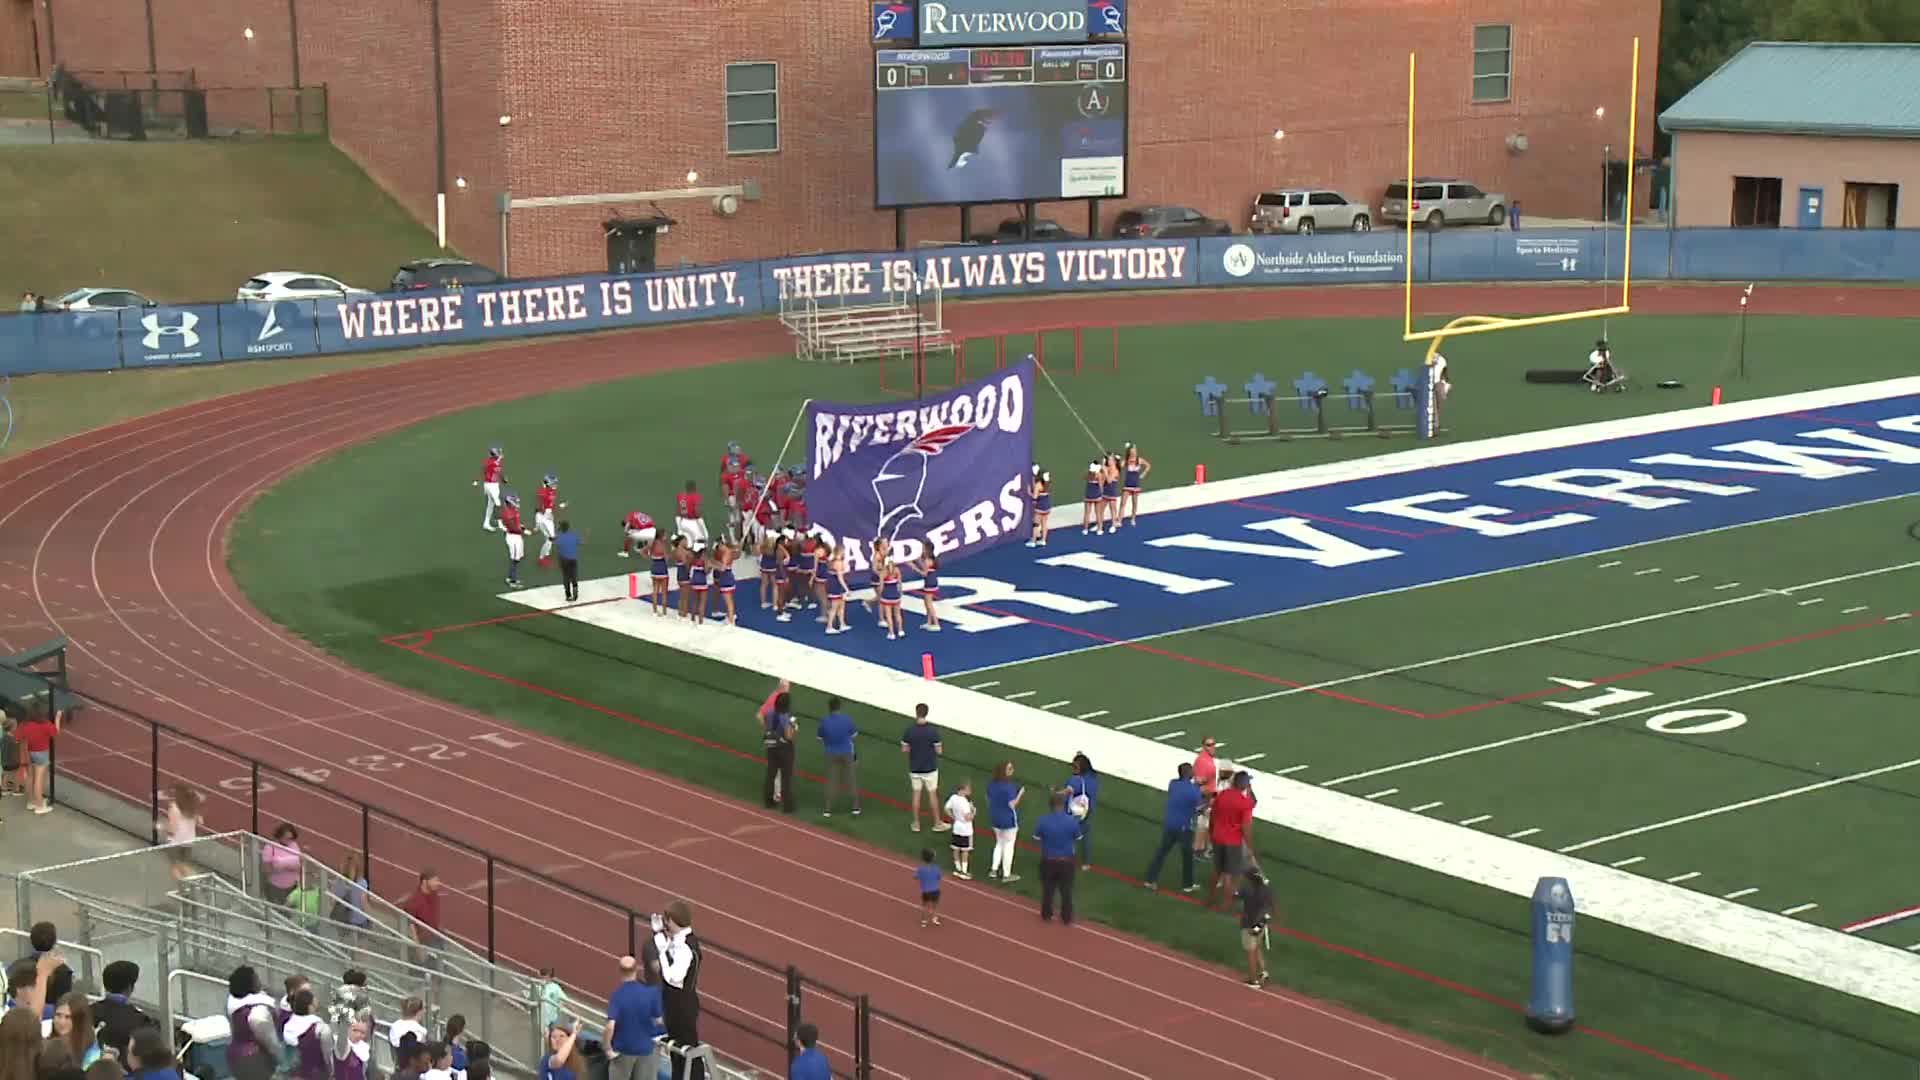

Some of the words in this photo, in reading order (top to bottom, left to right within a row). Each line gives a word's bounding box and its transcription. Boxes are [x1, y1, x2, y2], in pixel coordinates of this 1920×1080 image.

[923, 2, 1085, 34] RIVERWOOD
[887, 67, 898, 86] 0
[1105, 61, 1116, 78] 0
[773, 261, 871, 301] THERE
[881, 259, 913, 293] IS
[922, 250, 1046, 290] ALWAYS
[1056, 246, 1187, 282] VICTORY
[1347, 250, 1404, 265] Foundation
[336, 295, 463, 340] WHERE
[477, 283, 588, 327] THERE
[600, 280, 633, 316] IS
[645, 271, 745, 313] UNITY,
[814, 374, 1024, 480] RIVERWOOD
[842, 414, 1920, 633] RIVERW
